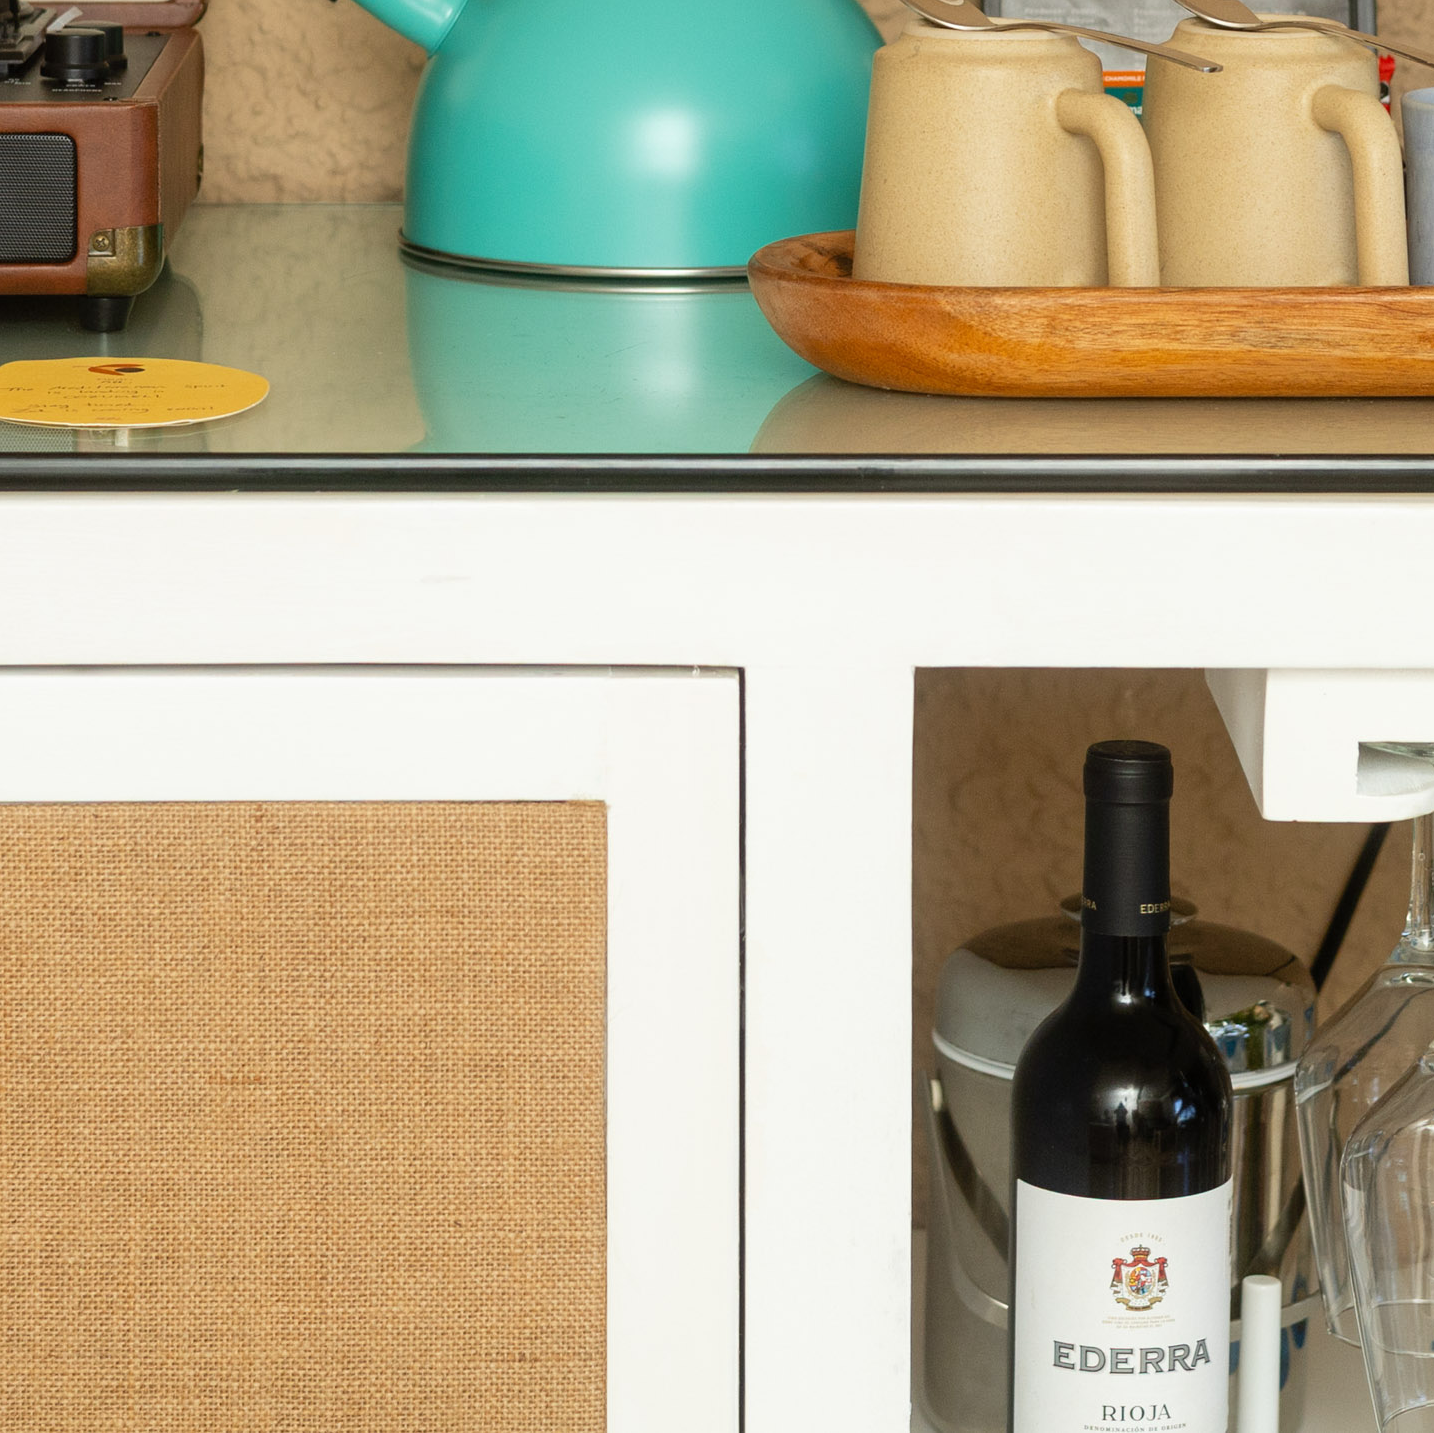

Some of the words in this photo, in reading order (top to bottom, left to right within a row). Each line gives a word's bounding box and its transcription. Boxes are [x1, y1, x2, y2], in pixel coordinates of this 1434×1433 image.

[1052, 1337, 1212, 1375] EDERRA
[1102, 1403, 1172, 1422] RIOJA
[1083, 1424, 1146, 1433] DENOMINACIÓN
[1160, 1422, 1187, 1432] ORIGEN
